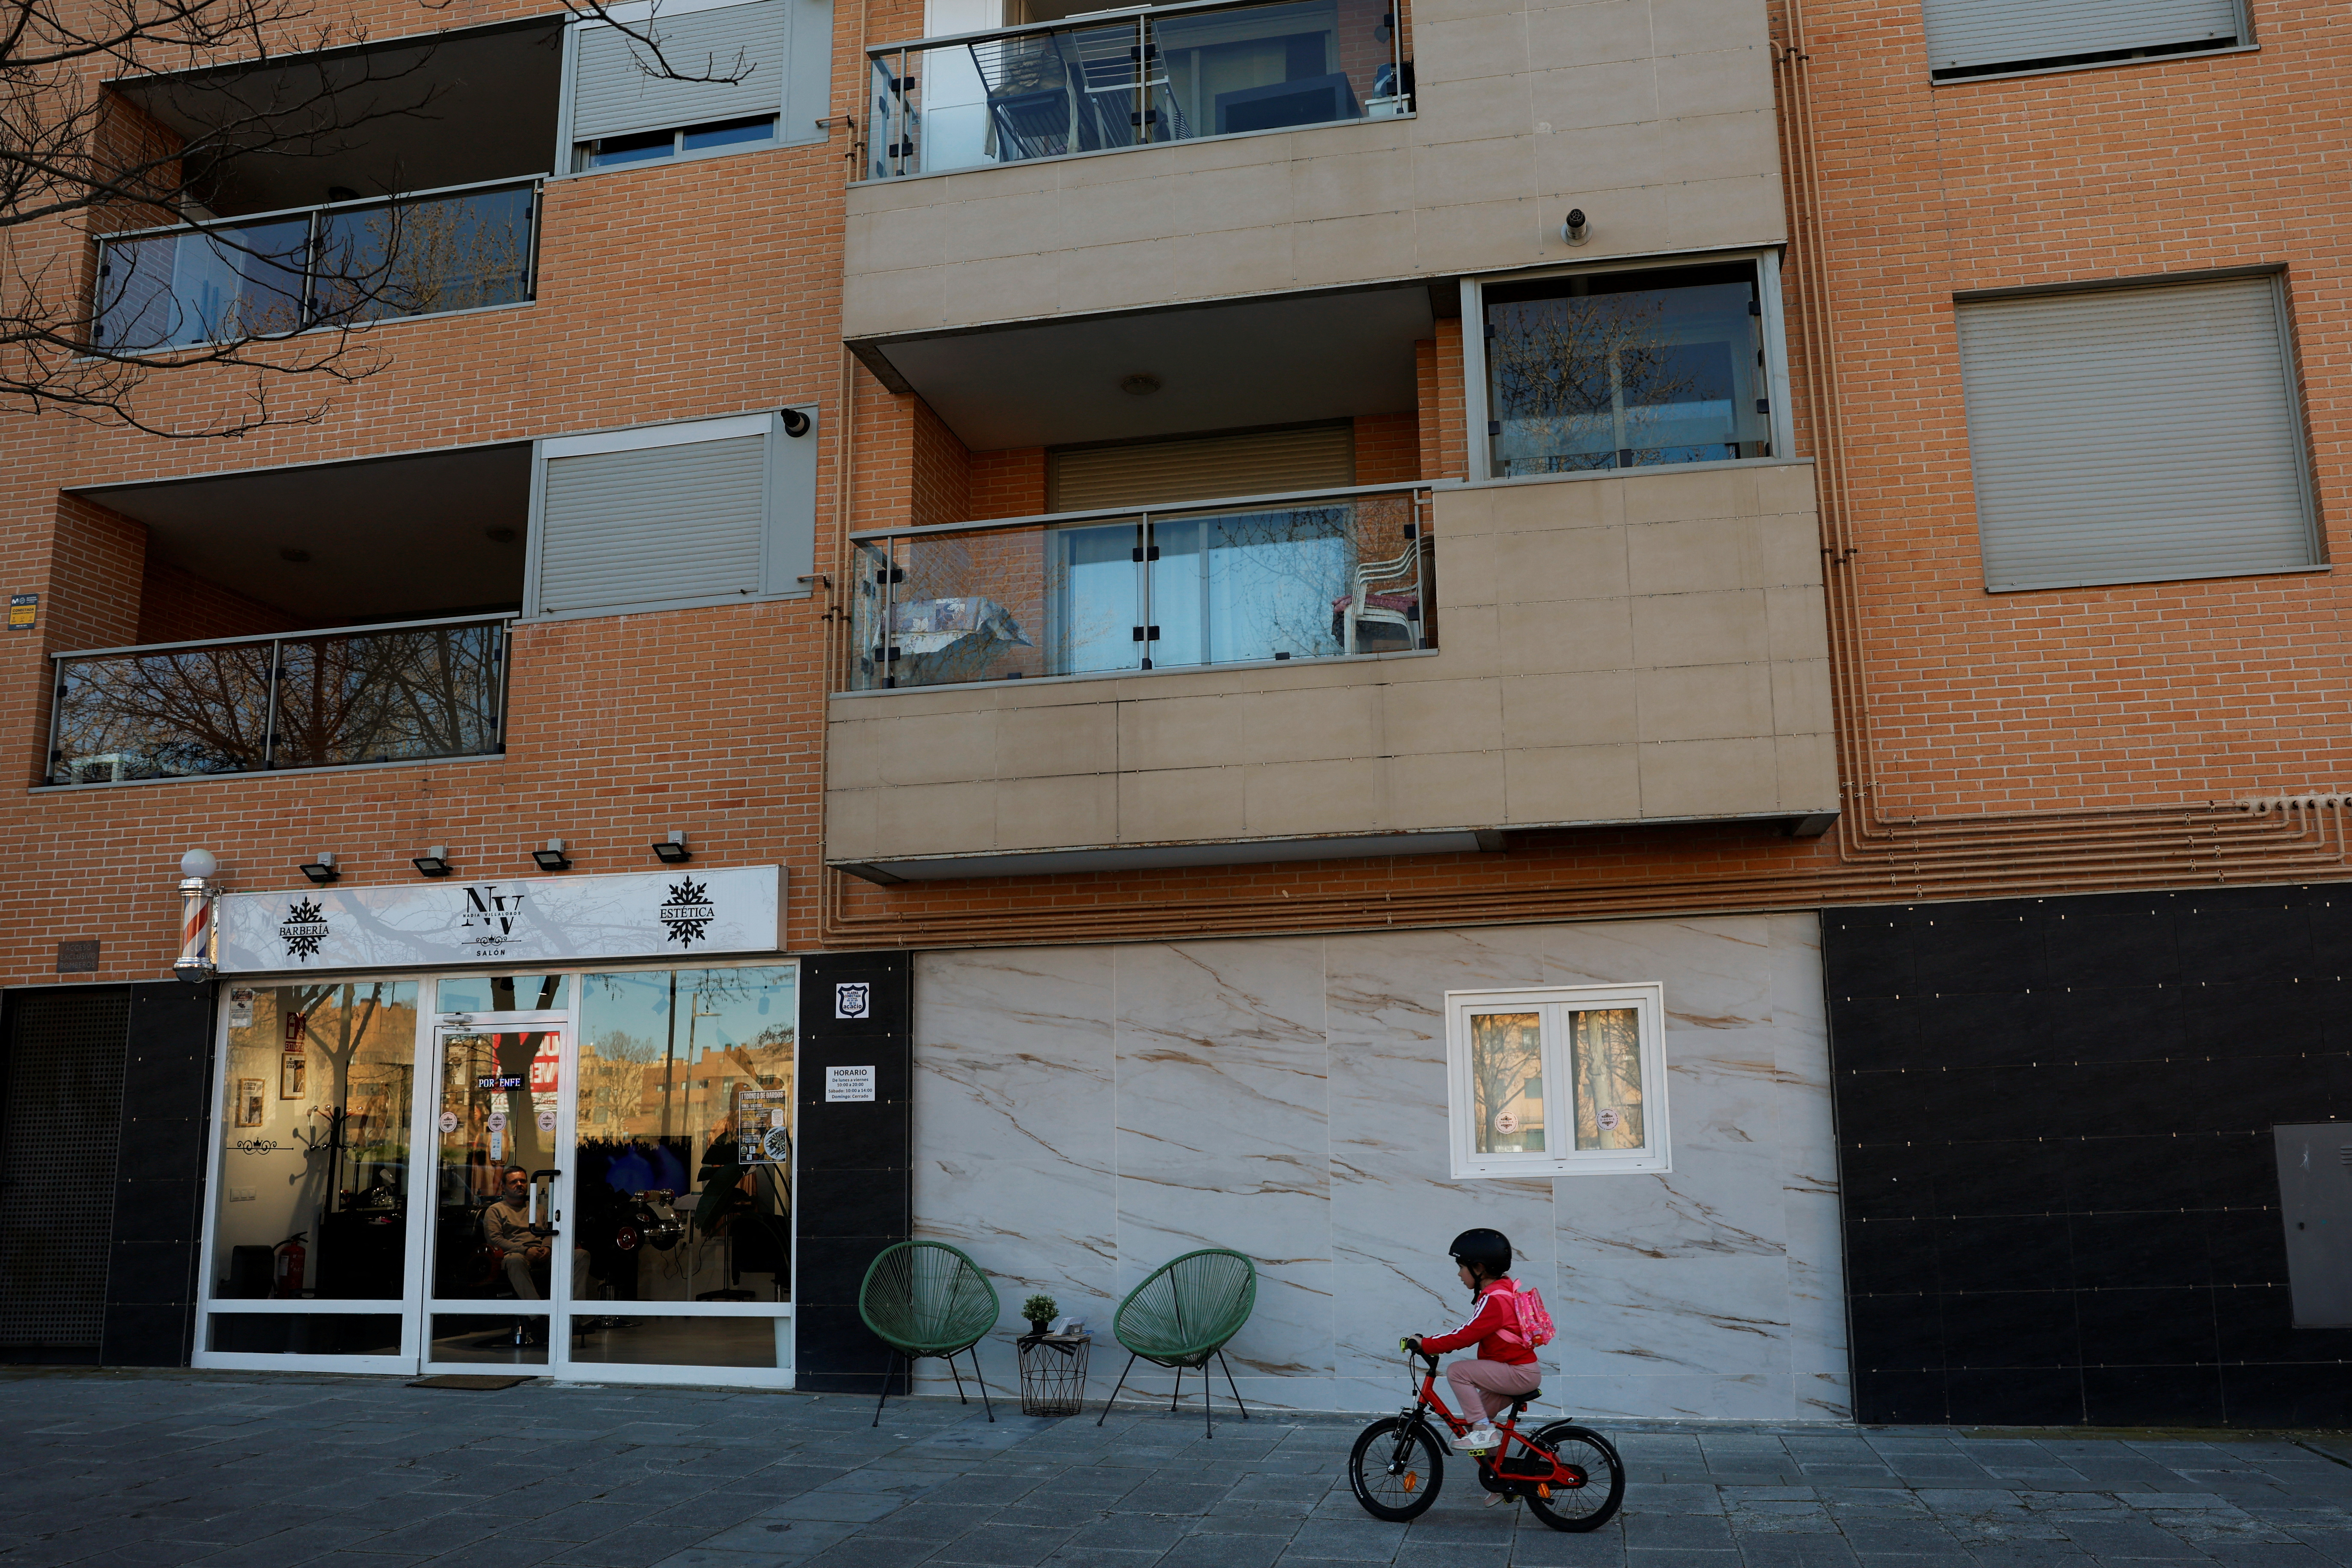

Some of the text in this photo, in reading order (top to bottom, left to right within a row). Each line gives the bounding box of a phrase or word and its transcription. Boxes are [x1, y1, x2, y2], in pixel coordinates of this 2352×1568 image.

[660, 906, 715, 919] ESTÉTICA
[279, 924, 330, 936] BARBERÍA
[476, 948, 505, 956] SALÓN
[285, 1042, 304, 1051] EXTINTOR
[478, 1078, 521, 1087] POR ENFE
